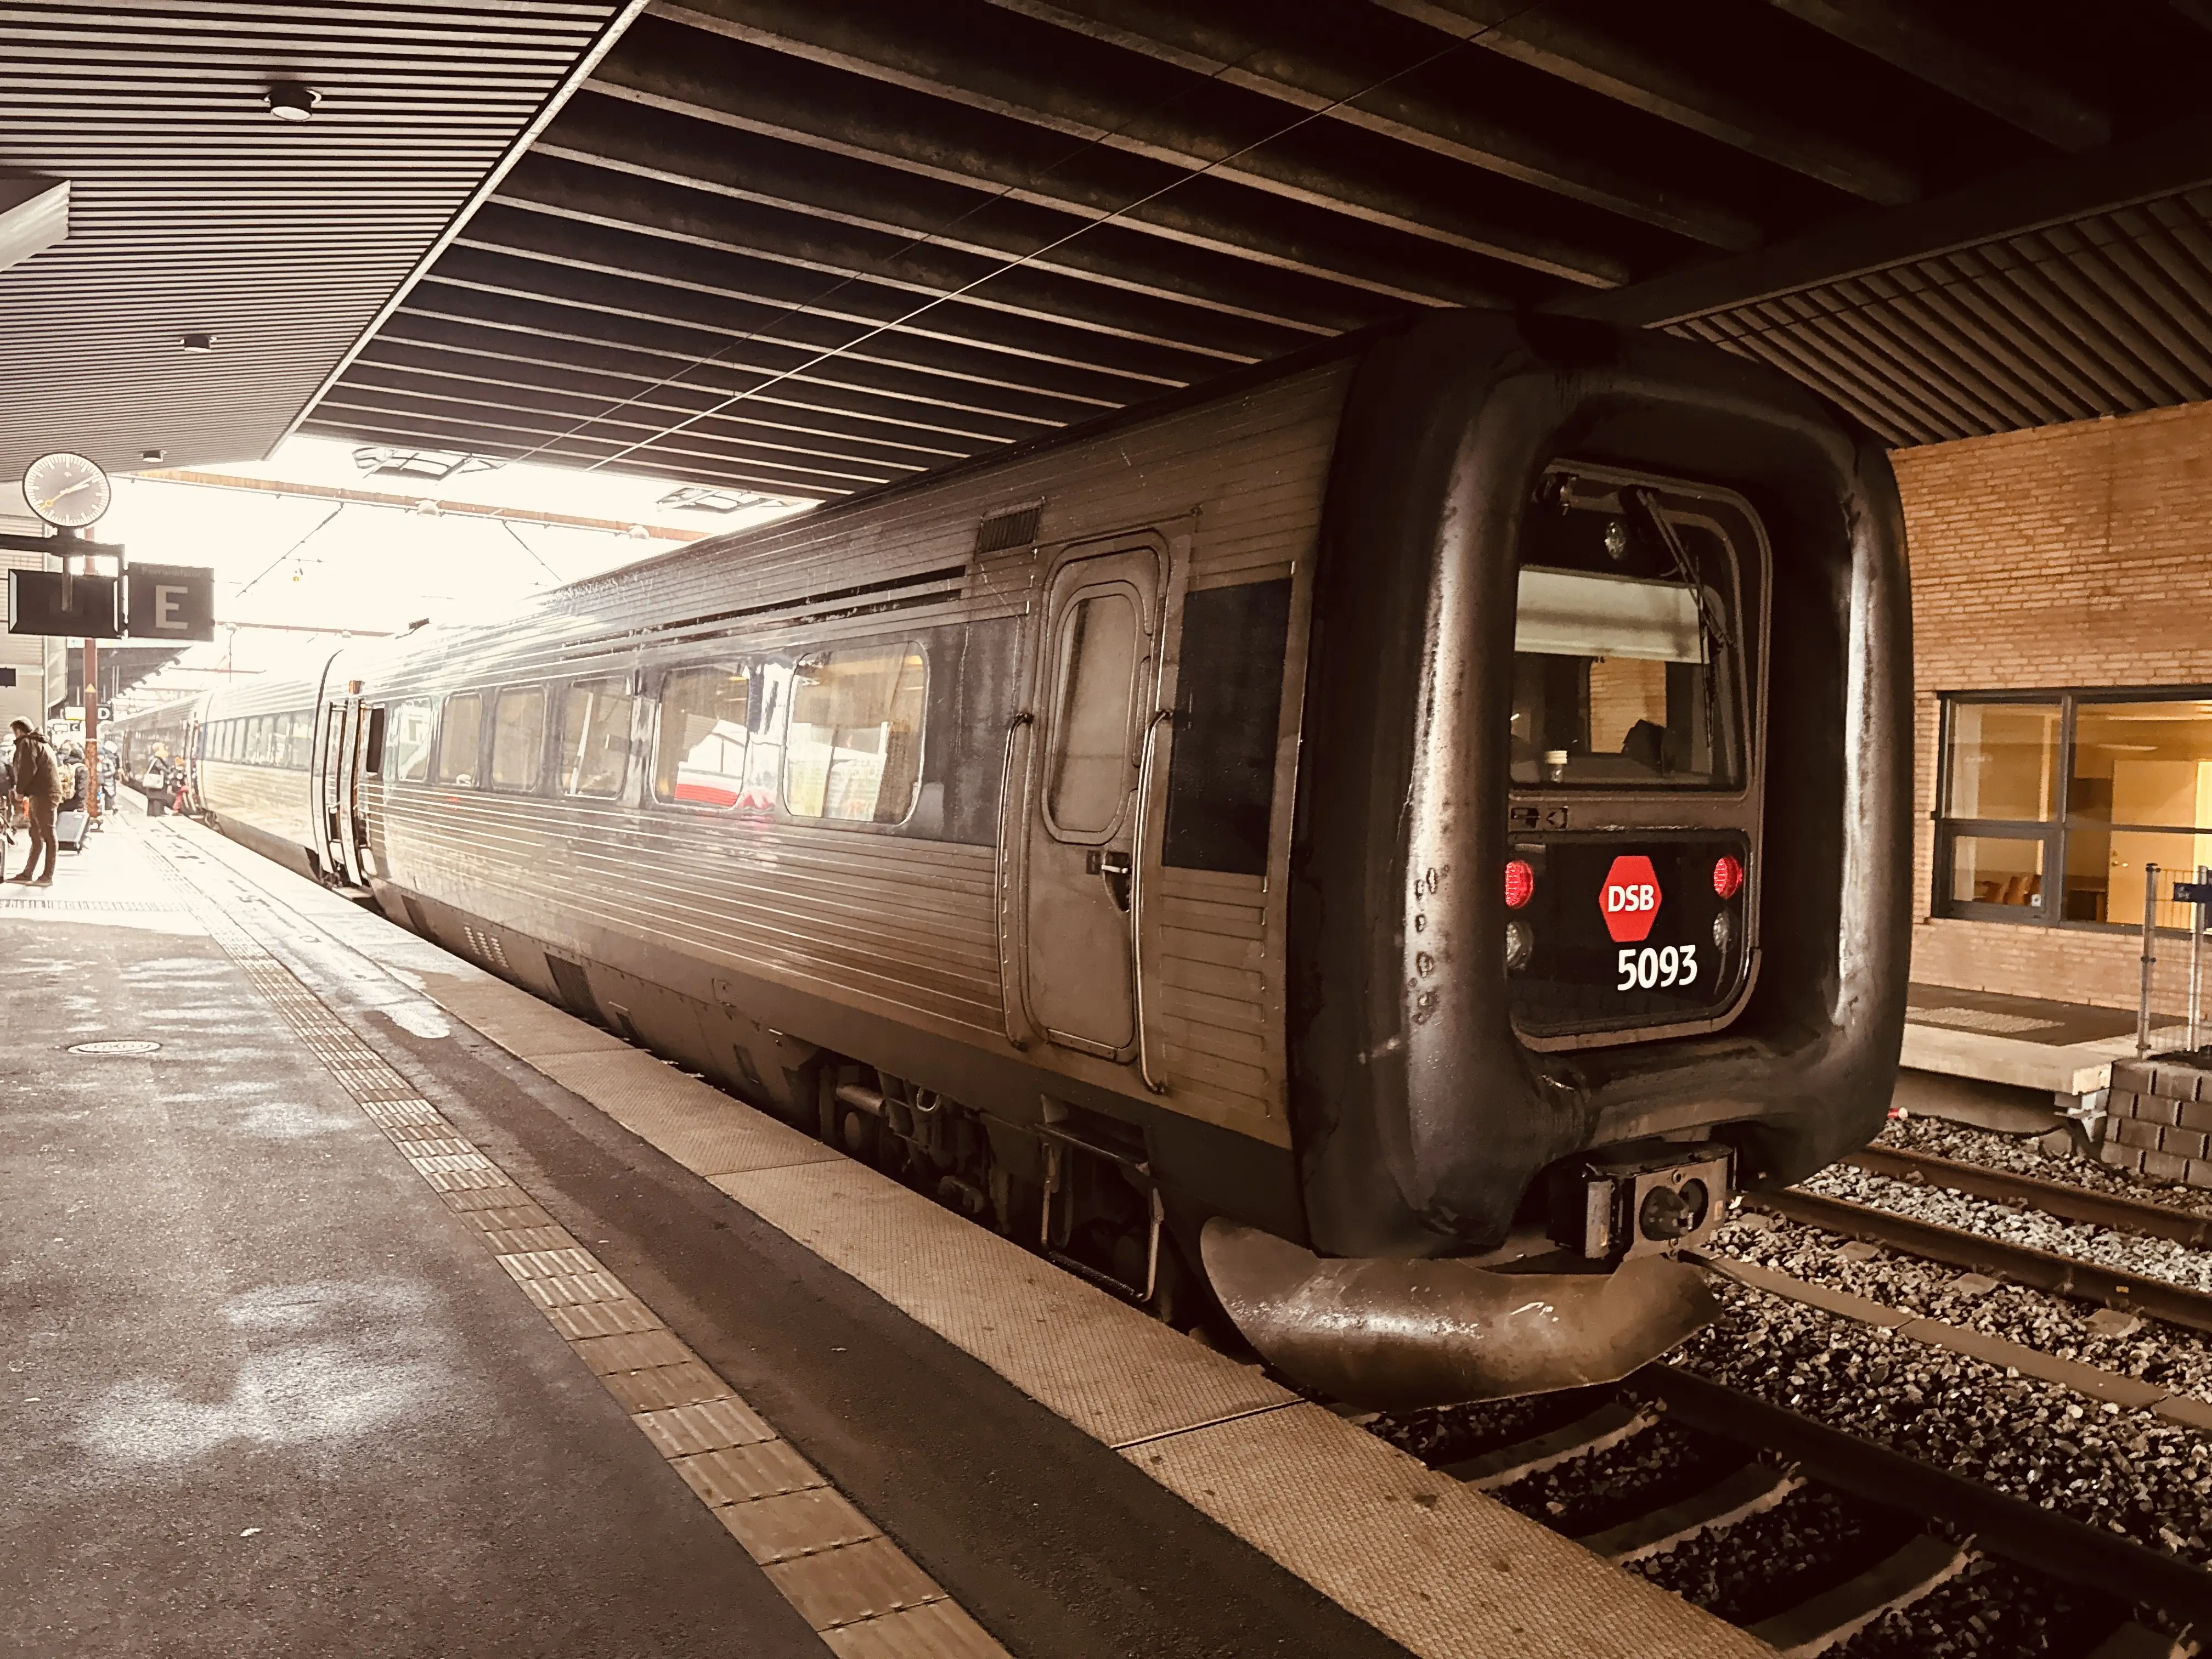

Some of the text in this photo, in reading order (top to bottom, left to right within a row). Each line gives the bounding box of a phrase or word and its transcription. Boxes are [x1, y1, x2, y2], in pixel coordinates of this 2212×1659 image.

[156, 585, 189, 630] E
[98, 708, 110, 720] D
[1608, 884, 1654, 912] DSB
[1617, 944, 1698, 991] 5093
